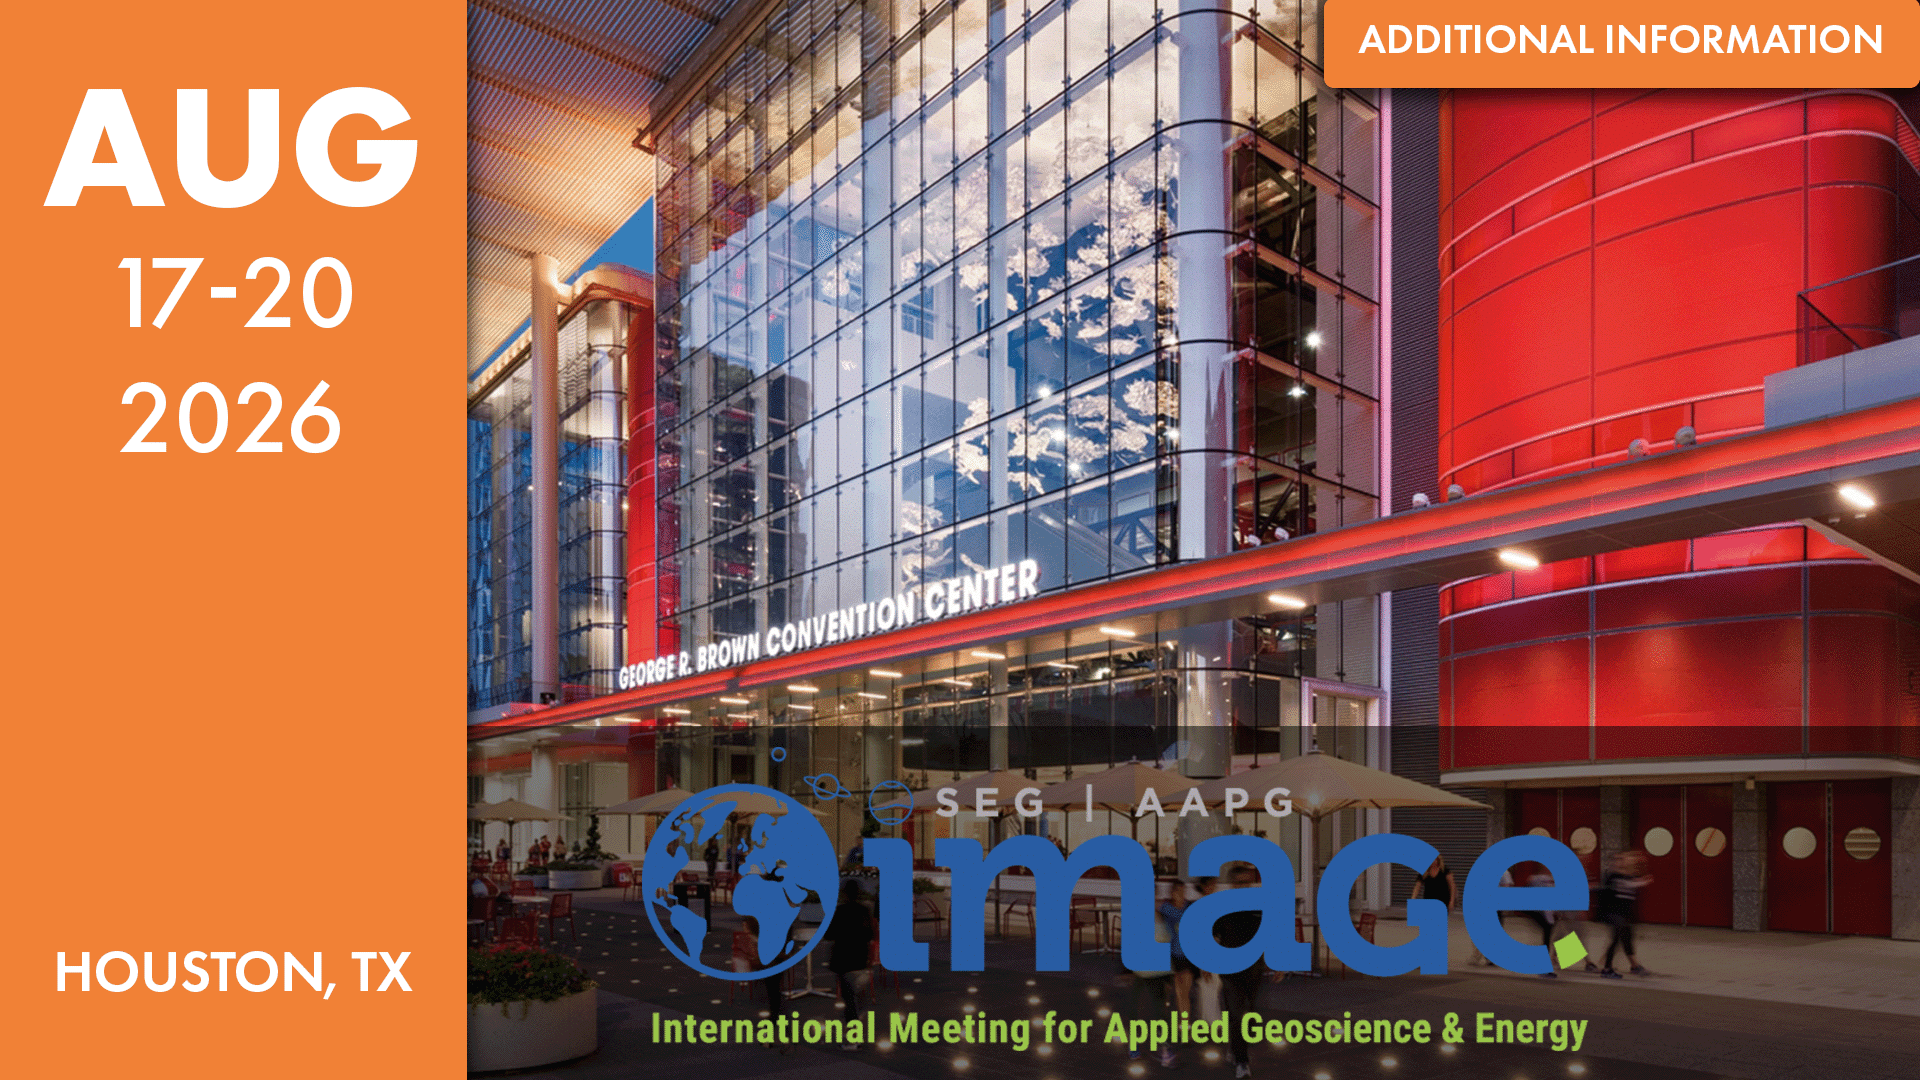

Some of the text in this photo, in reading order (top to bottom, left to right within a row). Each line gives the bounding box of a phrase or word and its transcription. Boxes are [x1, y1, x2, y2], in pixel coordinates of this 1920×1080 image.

[618, 558, 1039, 690] GEORGE R. BROWN CONVENTION CENTER
